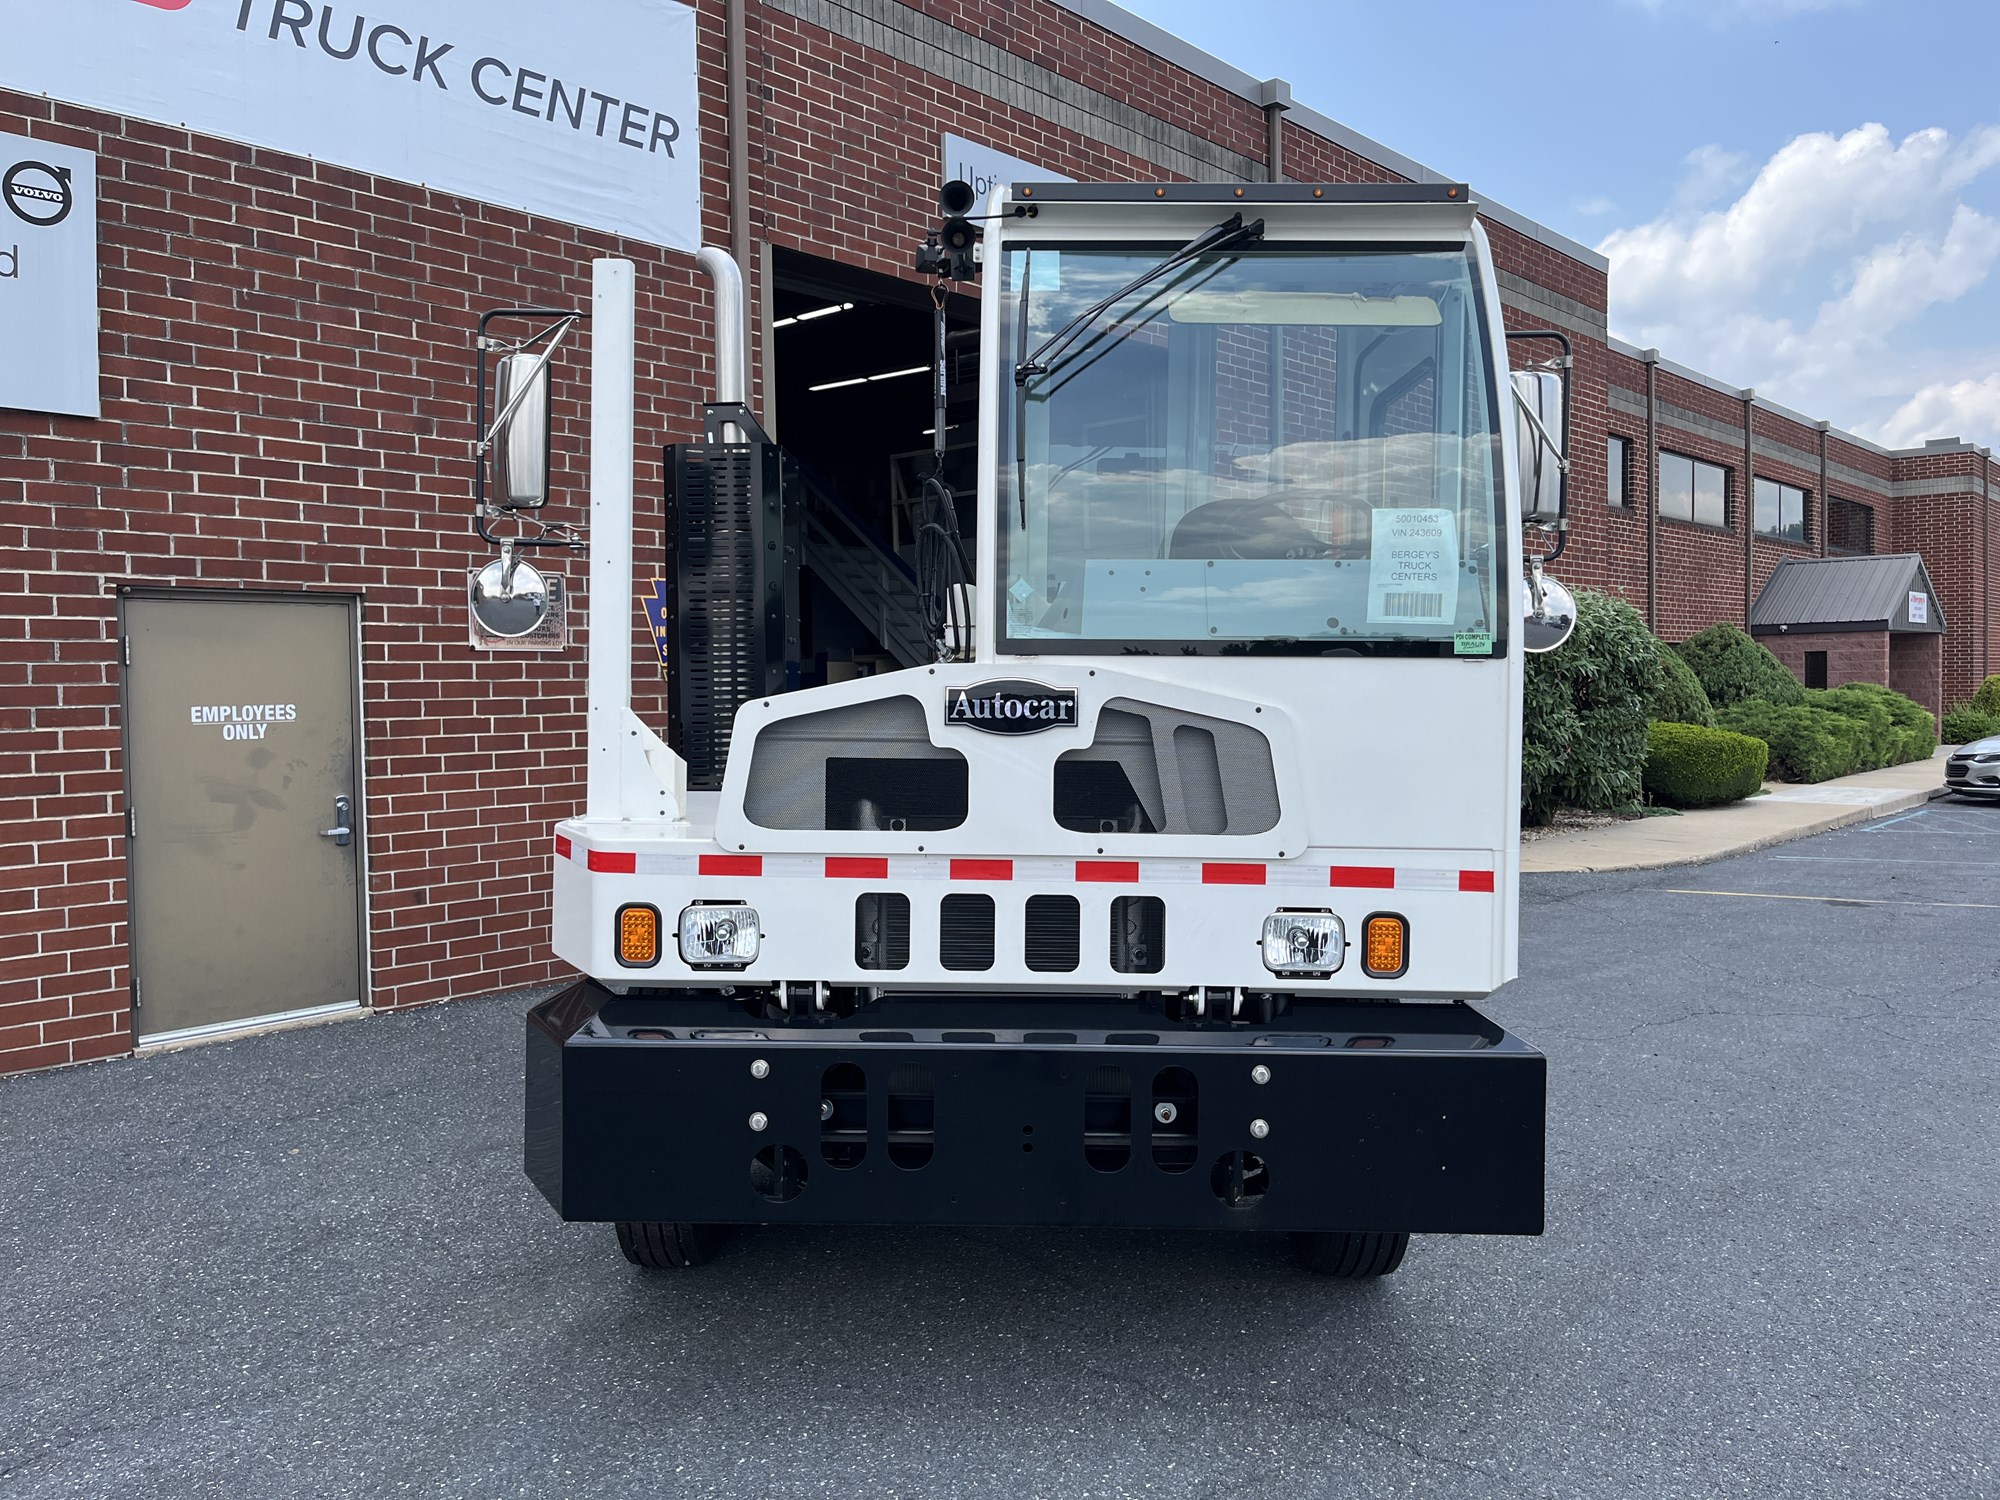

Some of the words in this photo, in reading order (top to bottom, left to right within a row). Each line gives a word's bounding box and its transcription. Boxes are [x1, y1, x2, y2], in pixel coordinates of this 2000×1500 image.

[471, 57, 680, 159] CENTER
[959, 162, 998, 201] Upt
[11, 185, 64, 202] VOLVO
[1395, 514, 1439, 523] 50010453
[1391, 528, 1407, 537] VIN
[1409, 528, 1443, 537] 243609
[1391, 550, 1440, 559] BERGEY'S
[1398, 561, 1432, 570] TRUCK
[1391, 572, 1438, 581] CENTERS
[1464, 633, 1490, 641] COMPLETE
[949, 690, 1074, 720] Autocar
[190, 703, 297, 723] EMPLOYEES
[222, 723, 268, 741] ONLY
